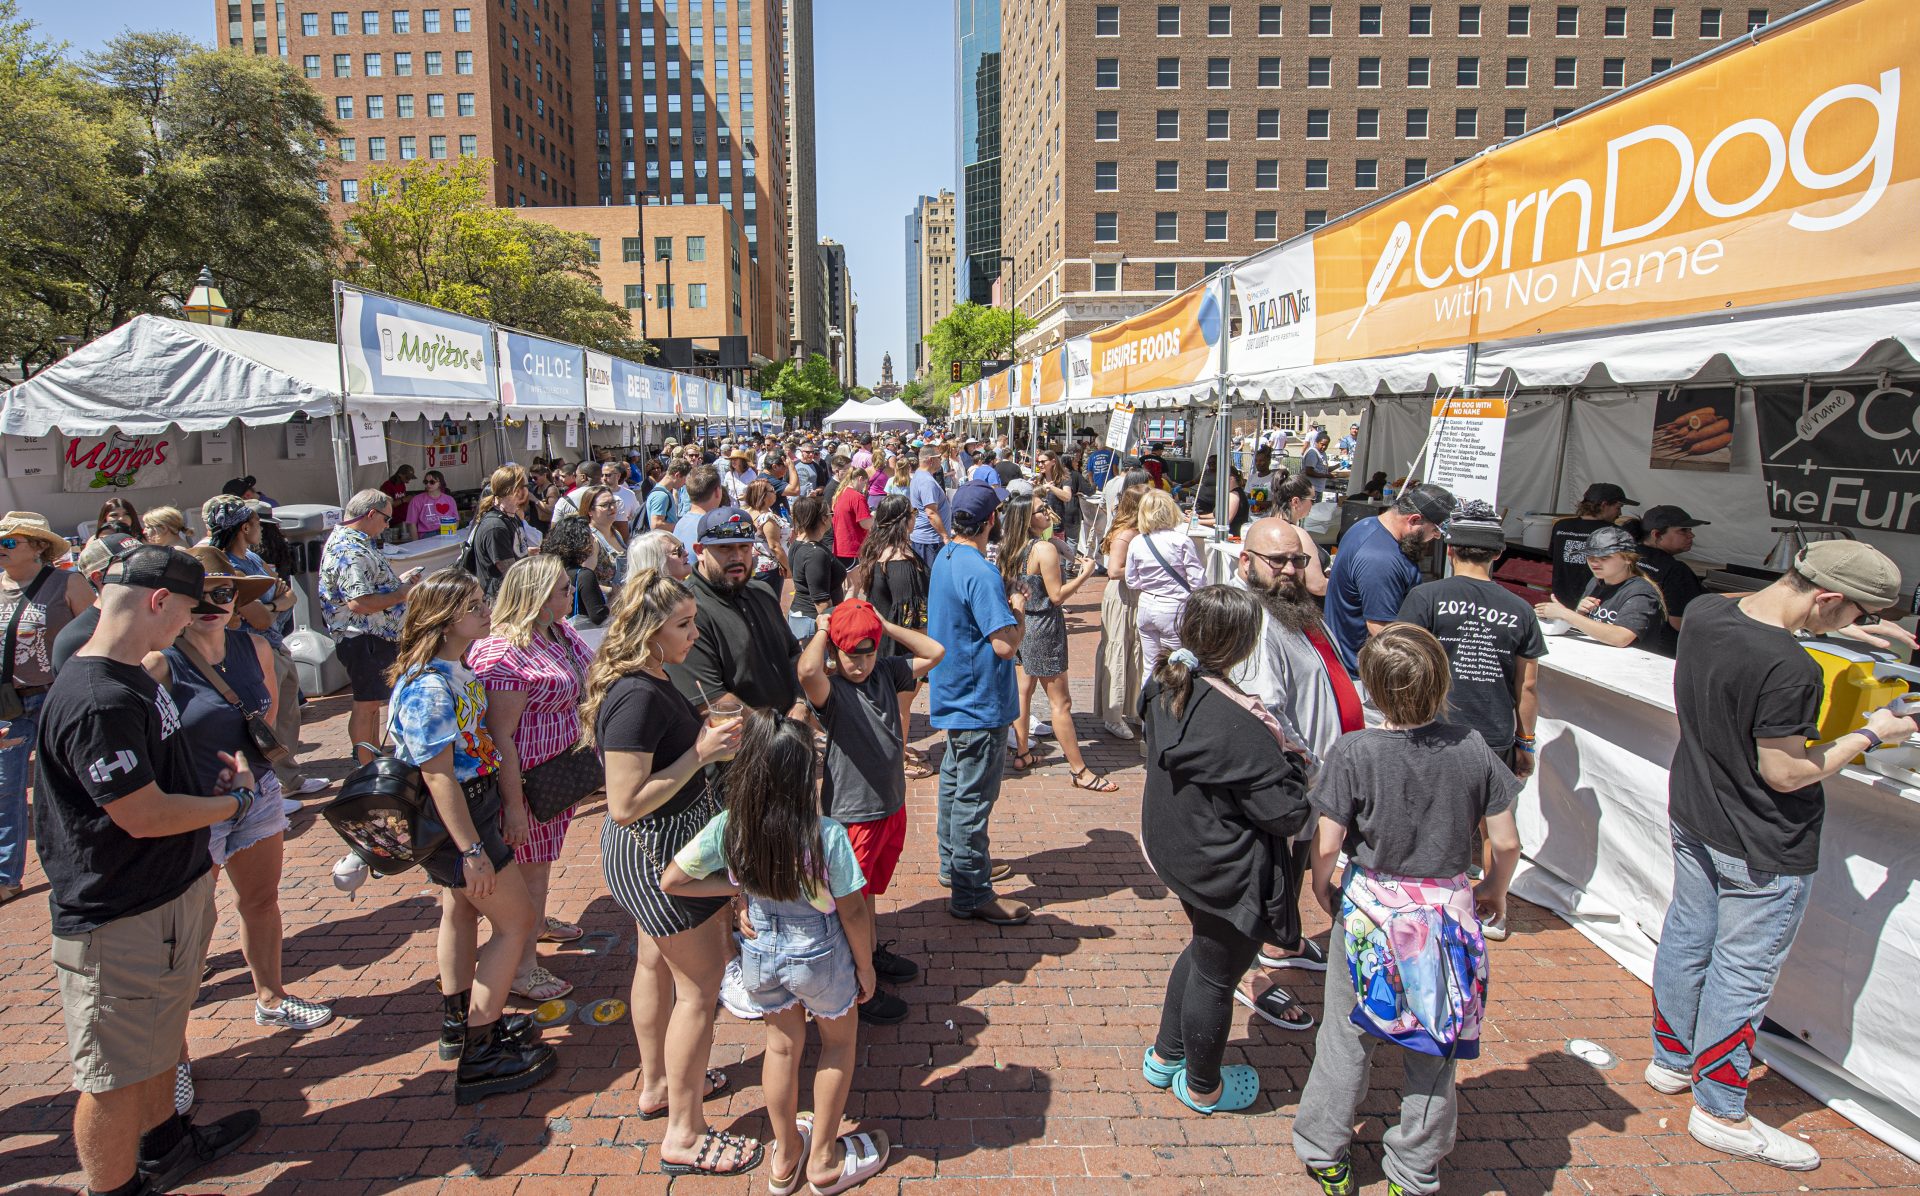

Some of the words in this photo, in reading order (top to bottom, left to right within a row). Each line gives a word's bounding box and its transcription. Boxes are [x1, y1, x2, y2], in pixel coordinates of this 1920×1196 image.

[1433, 281, 1492, 322] with
[1505, 269, 1557, 308] No
[1570, 238, 1725, 298] Name
[1249, 289, 1303, 335] MAIN
[1301, 296, 1311, 313] ST.
[397, 332, 469, 372] Mojitos
[523, 353, 573, 379] CHLOE
[1102, 341, 1138, 373] LEISURE
[1140, 328, 1181, 365] FOODS
[628, 374, 651, 400] BEER
[1811, 396, 1846, 424] name
[1438, 600, 1476, 615] 2021
[1478, 606, 1518, 628] 2022
